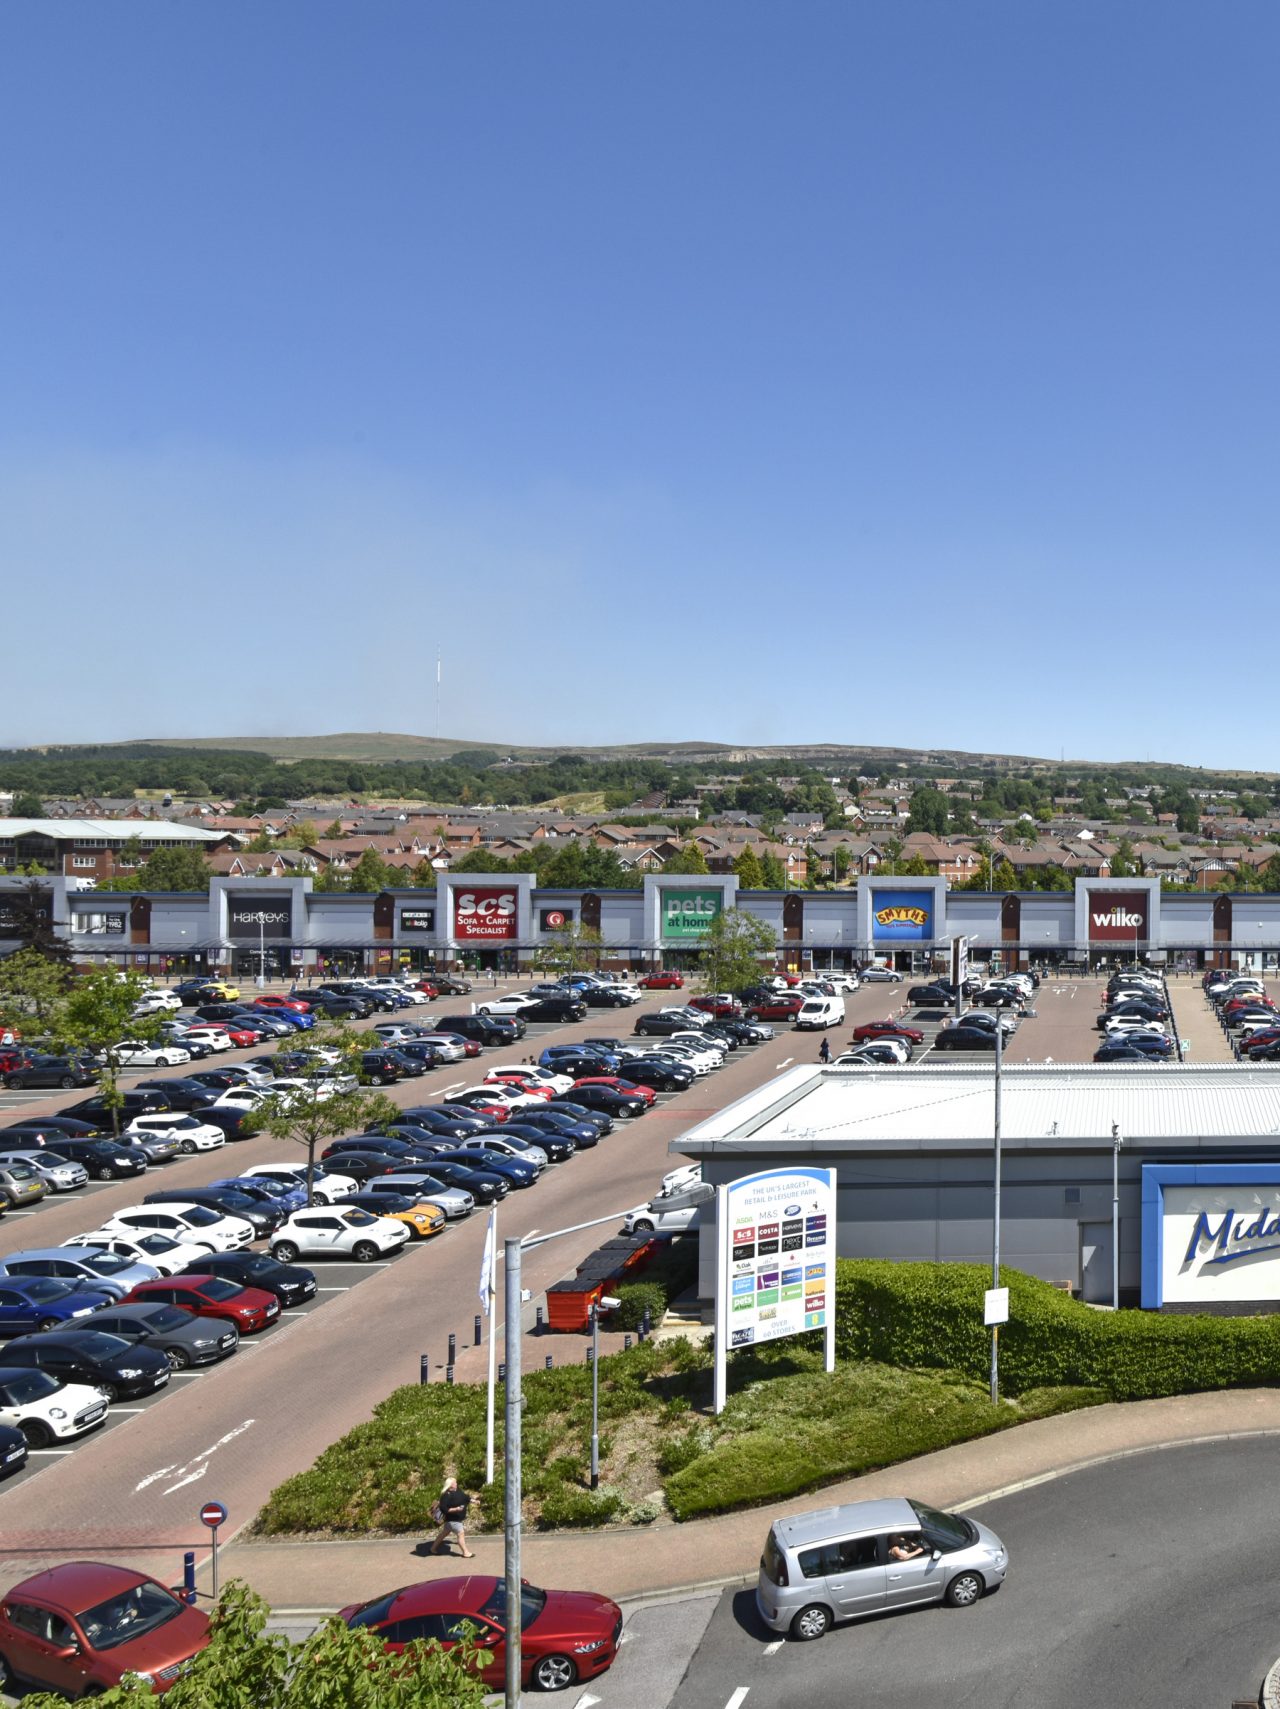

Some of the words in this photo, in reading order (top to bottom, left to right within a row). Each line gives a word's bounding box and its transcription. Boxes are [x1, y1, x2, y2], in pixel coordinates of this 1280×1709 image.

[458, 894, 515, 915] ScS
[668, 896, 716, 918] pets
[878, 909, 928, 923] SMYTHS
[1093, 907, 1143, 927] wilko
[668, 917, 680, 927] at
[782, 1181, 810, 1190] LARGEST
[744, 1196, 766, 1205] RETAIL
[774, 1192, 799, 1200] LEISURE
[759, 1210, 778, 1220] M&S
[734, 1296, 752, 1306] pets
[807, 1299, 824, 1308] wilko
